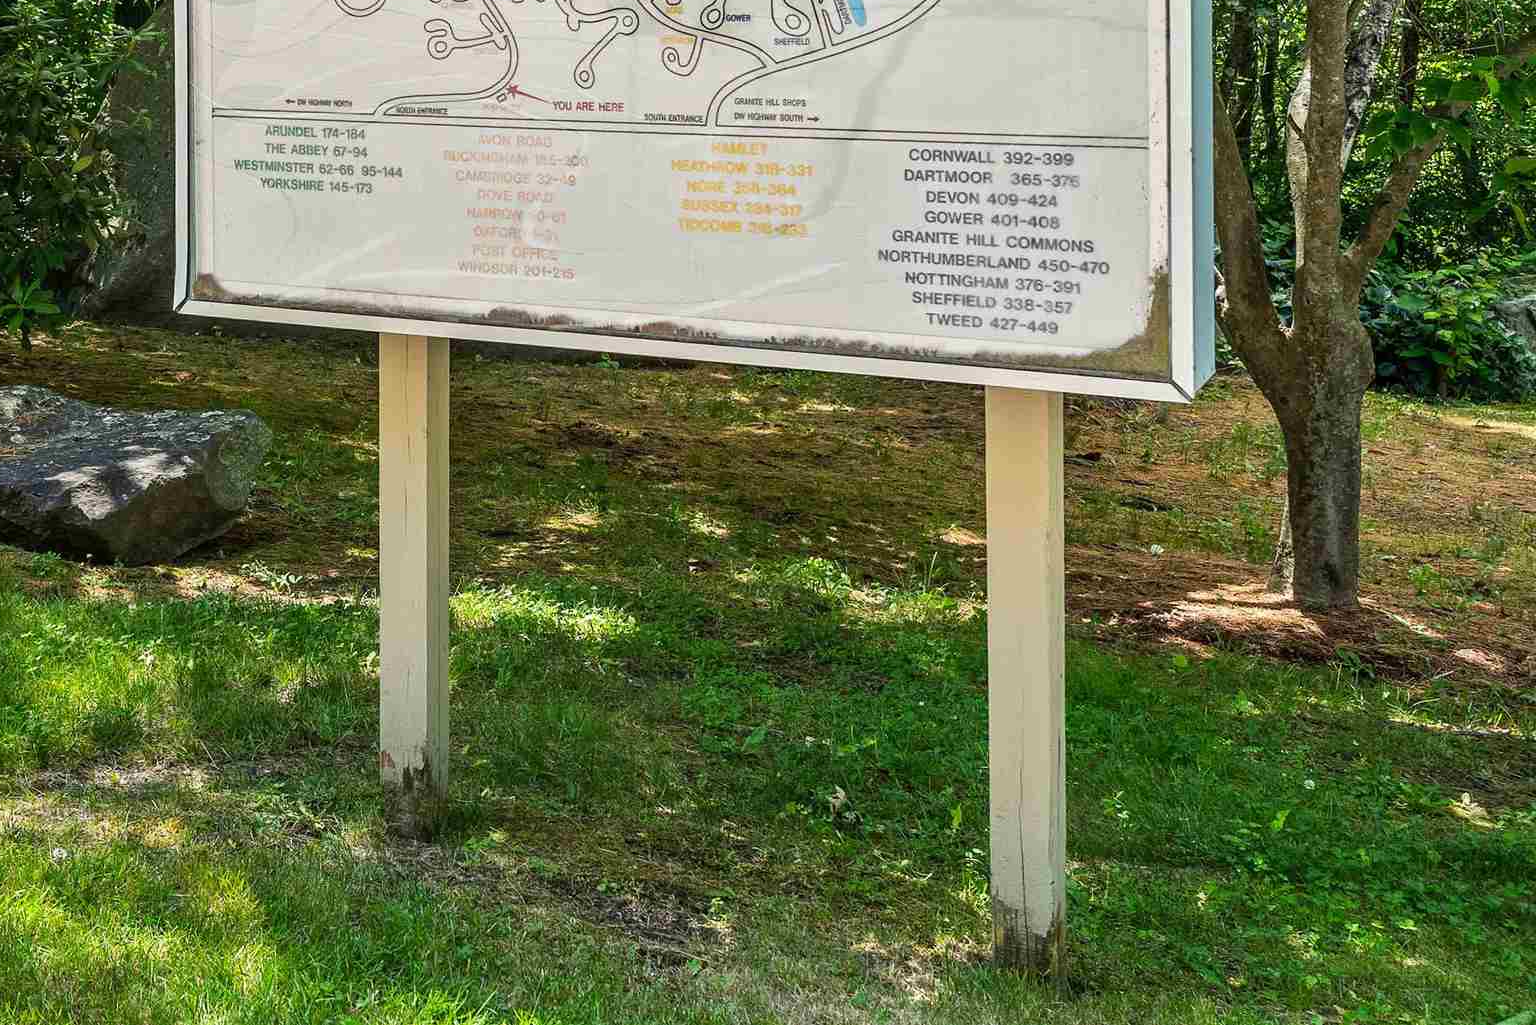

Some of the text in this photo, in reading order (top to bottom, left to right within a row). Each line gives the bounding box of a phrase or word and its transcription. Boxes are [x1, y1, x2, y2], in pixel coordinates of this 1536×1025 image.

[725, 14, 751, 23] GOWER
[774, 37, 810, 46] SHEFFIELD
[552, 101, 625, 112] YOU ARE HERE
[734, 97, 807, 107] GRANITE HILL SHOPS
[644, 113, 704, 123] SOUTH ENTRANCE
[747, 113, 777, 122] HIGHWAY
[779, 114, 804, 123] SOUTH
[265, 125, 366, 140] ARUNDEL 174-184
[516, 135, 553, 148] ROAD
[711, 142, 769, 155] HAMLET
[264, 143, 368, 158] THE ABBEY 67-94
[908, 148, 1075, 167] CORNWALL 392-399
[233, 159, 403, 178] WESTMINSTER 62-66 95-144
[260, 177, 373, 194] YORKSHIRE 145-173
[904, 168, 1081, 188] DARTMOOR 365-375
[517, 190, 553, 203] ROAD
[926, 191, 1058, 208] DEVON 409-424
[924, 211, 1061, 229] GOWER 401-408
[891, 229, 1095, 254] GRANITE HILL COMMONS
[511, 246, 559, 261] OFFICE
[457, 259, 519, 275] WINDSOR
[878, 249, 1111, 275] NORTHUMBERLAND 450-470
[904, 271, 1082, 294] NOTTINGHAM 376-391
[912, 291, 1073, 315] SHEFFIELD 338-357
[925, 312, 1059, 334] TWEED 427-449
